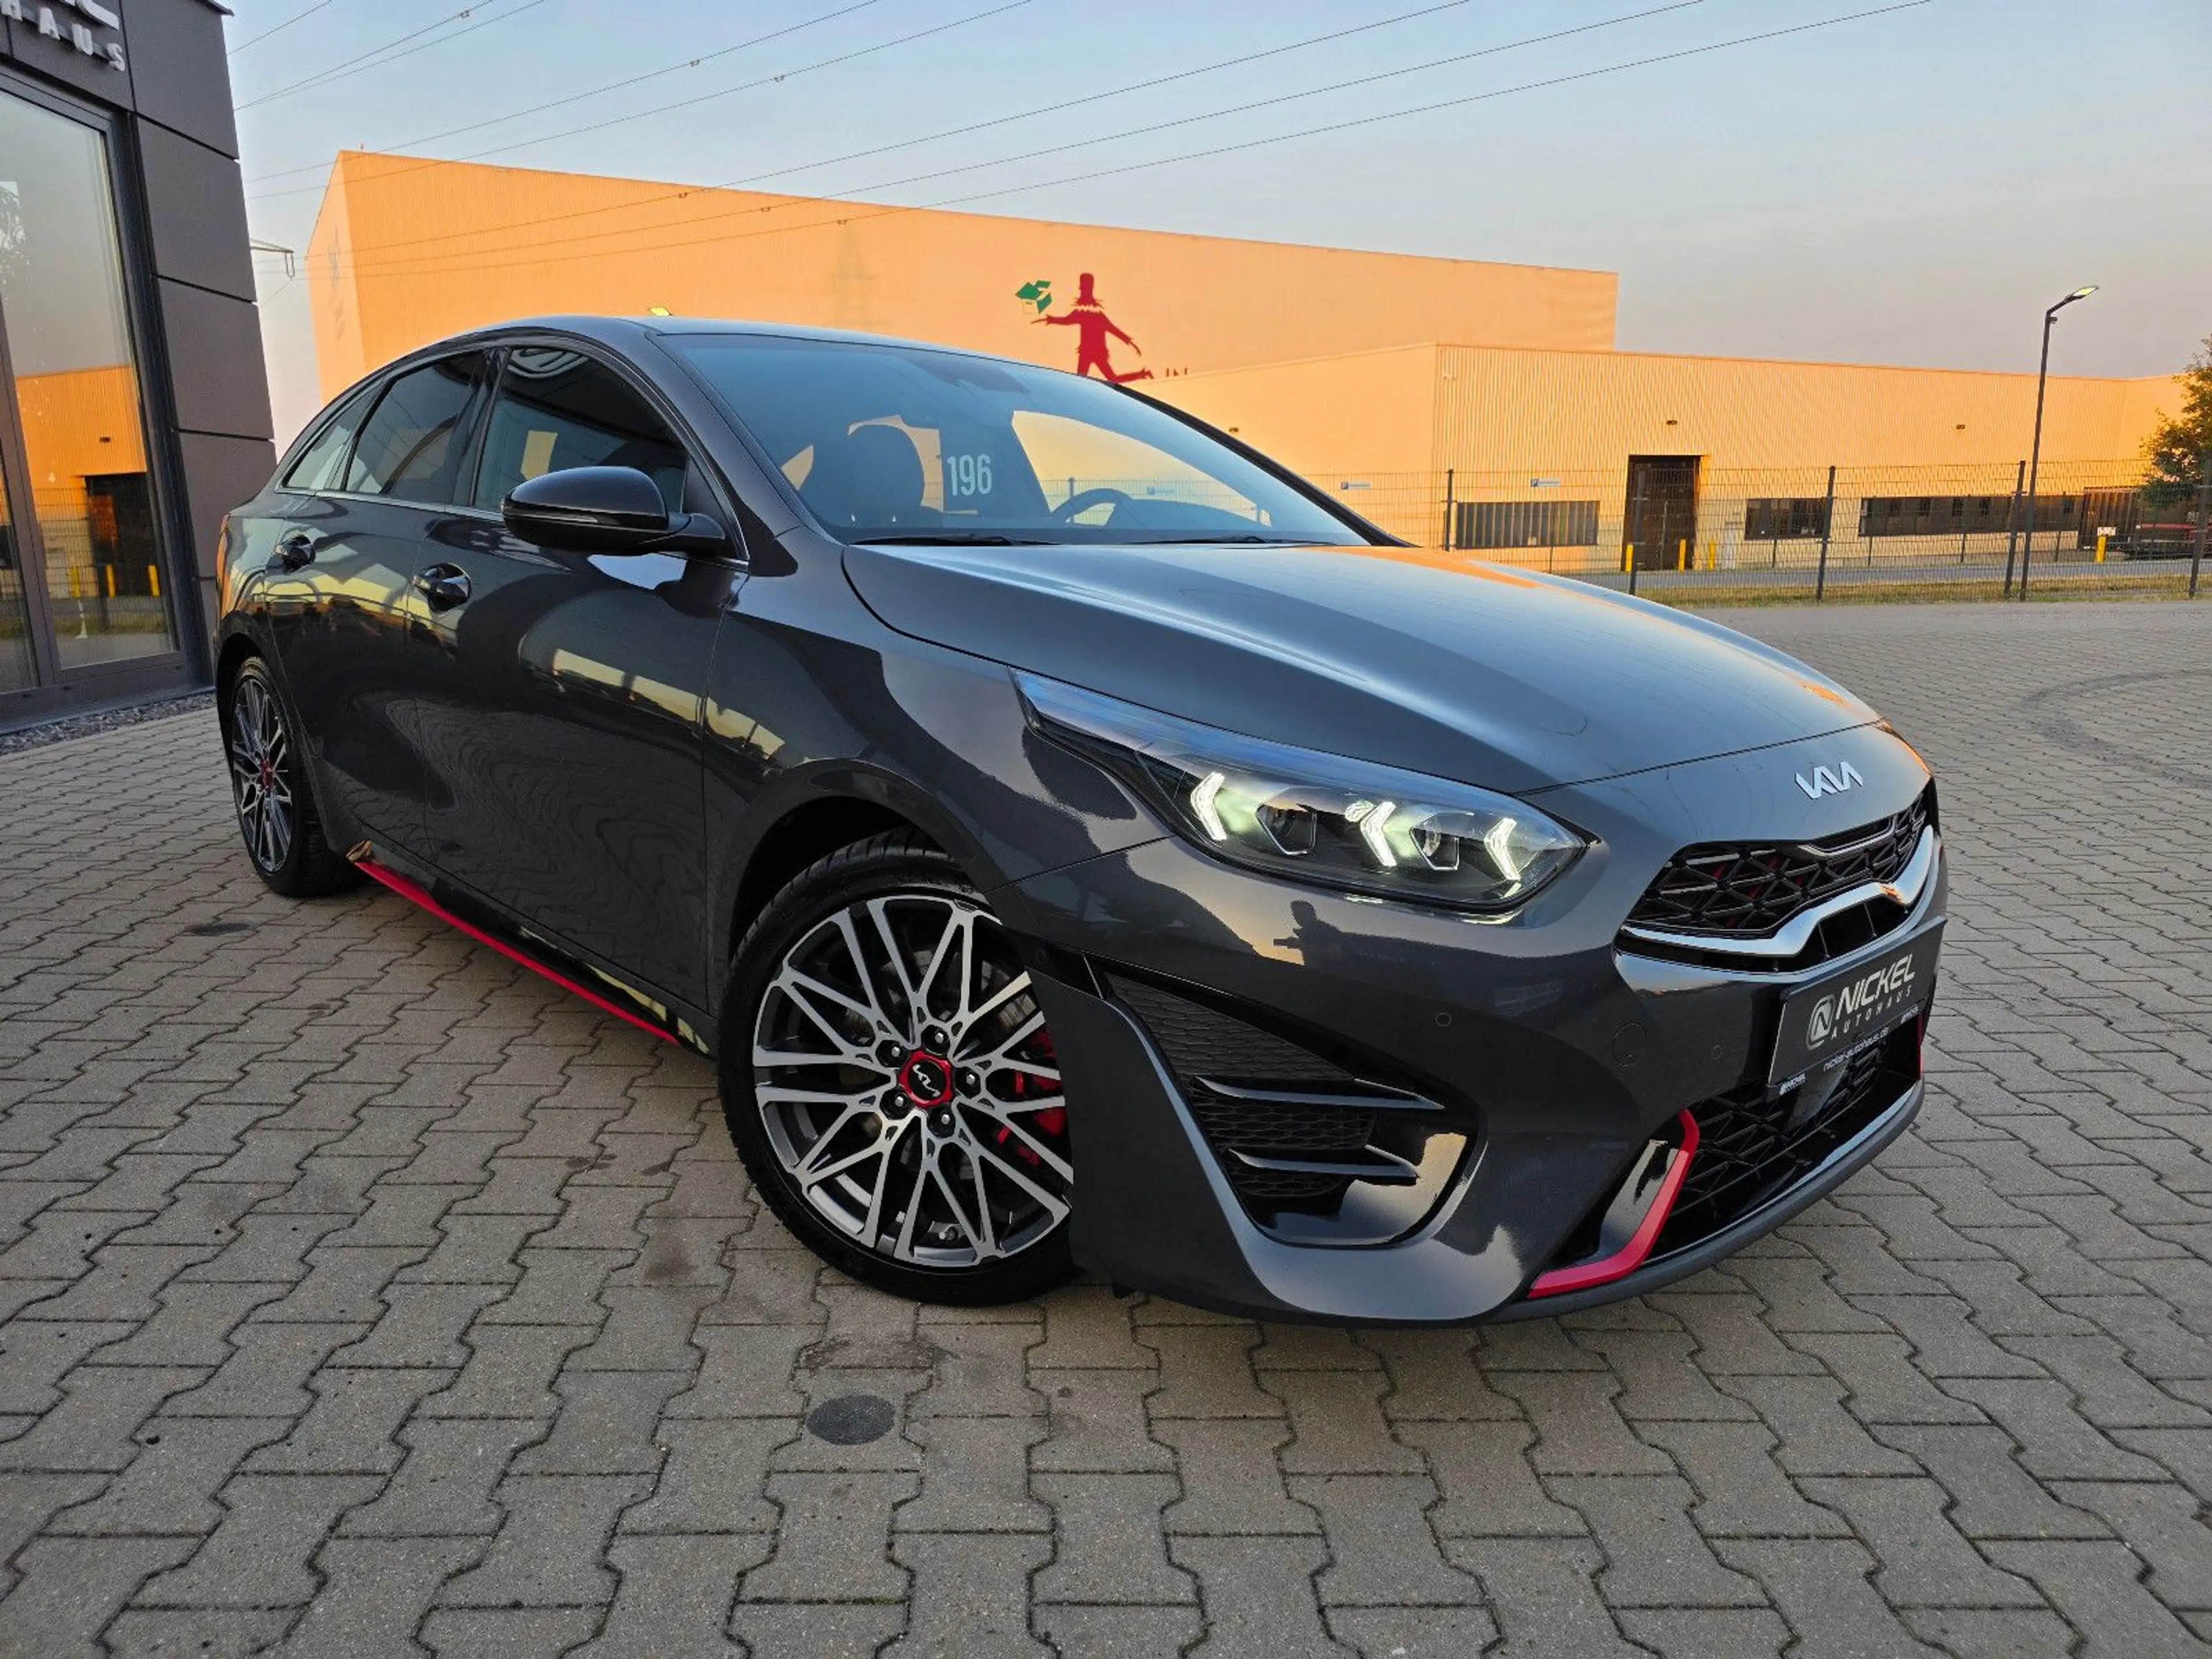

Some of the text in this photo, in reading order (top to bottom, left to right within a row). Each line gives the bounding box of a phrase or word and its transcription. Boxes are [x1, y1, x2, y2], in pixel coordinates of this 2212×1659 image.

[947, 453, 993, 497] 196
[1831, 984, 1912, 1040] AUTOHAUS
[1836, 953, 1915, 1020] NICKEL
